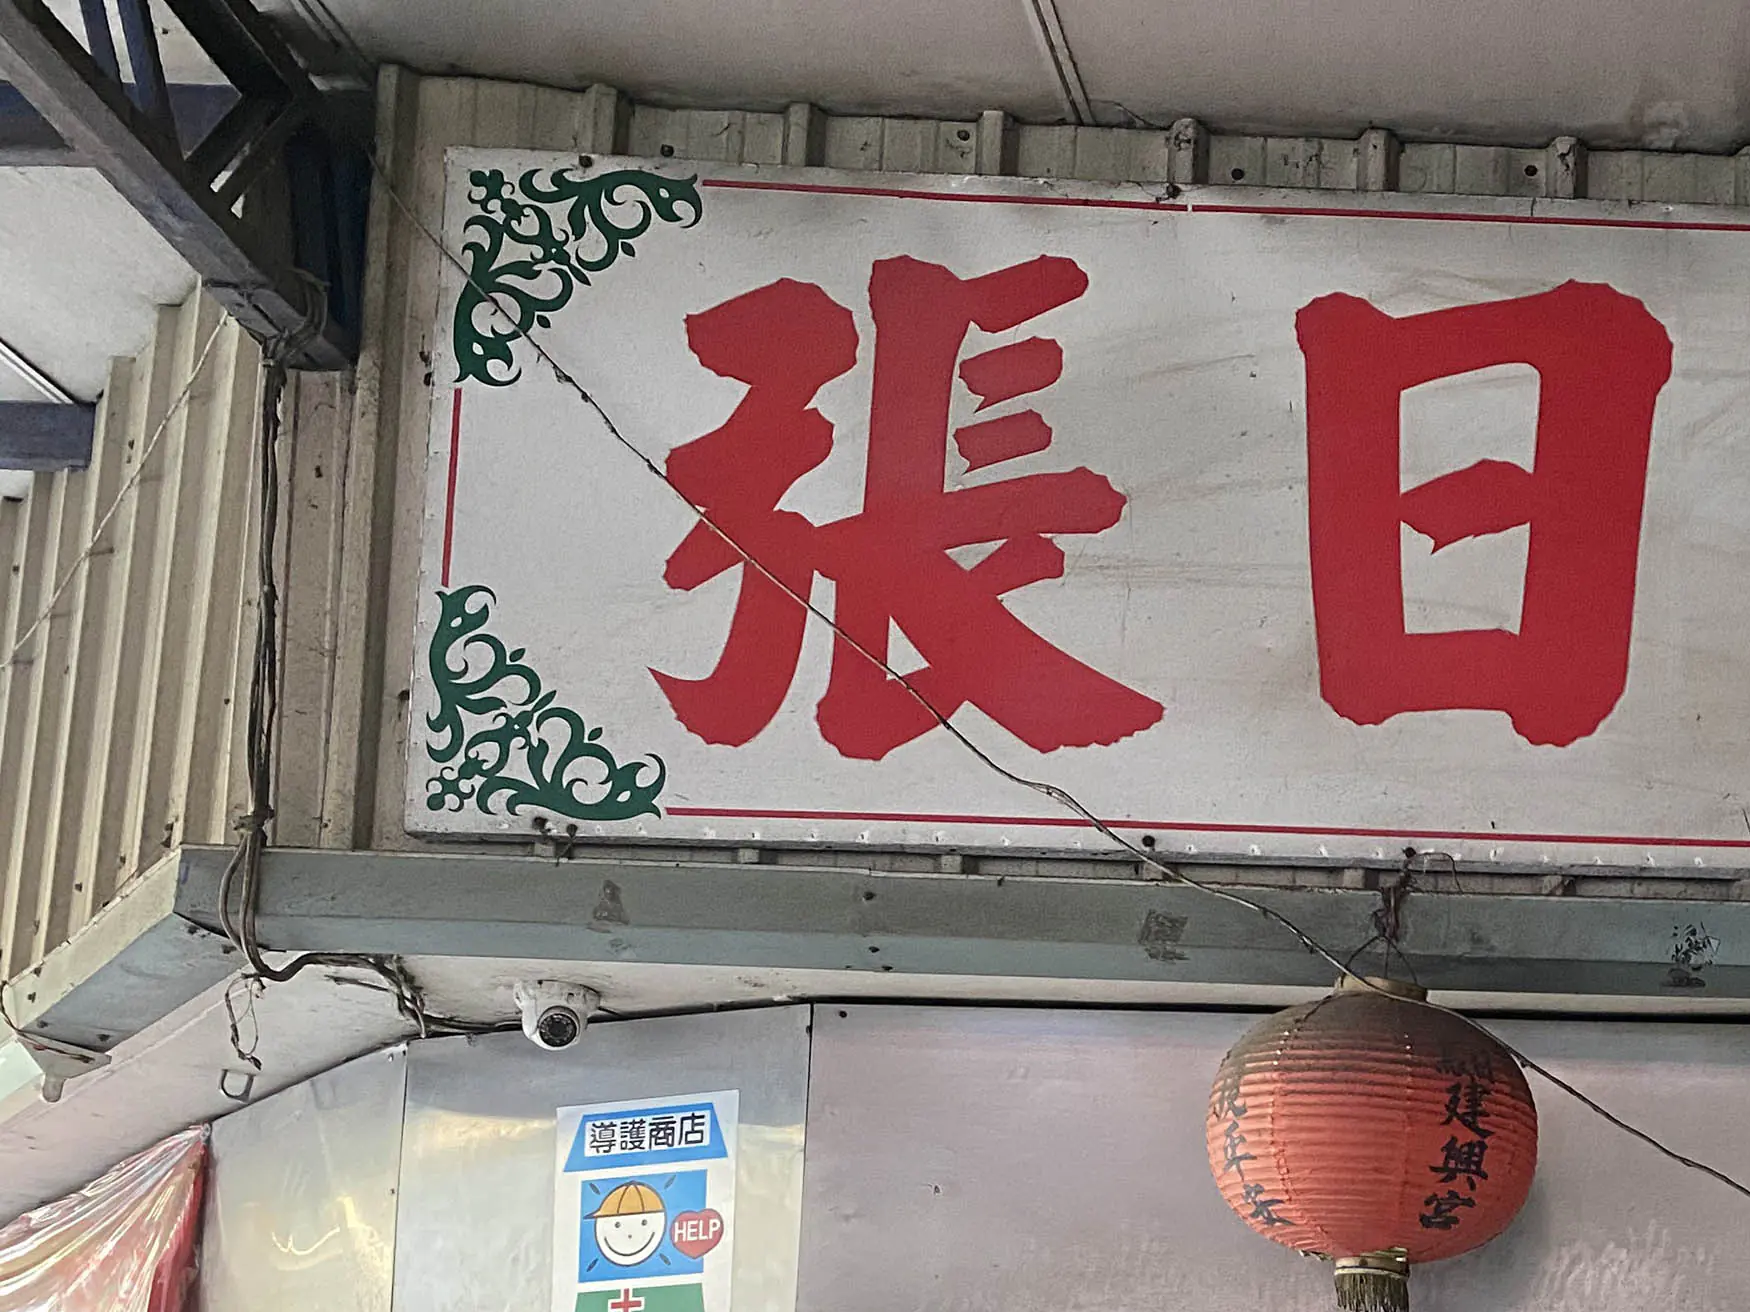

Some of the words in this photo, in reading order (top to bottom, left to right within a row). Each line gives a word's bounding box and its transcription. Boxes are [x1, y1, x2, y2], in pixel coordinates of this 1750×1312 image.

[588, 1112, 706, 1154] 導護商店
[1419, 1078, 1495, 1230] 建興宮
[673, 1216, 721, 1243] HELP
